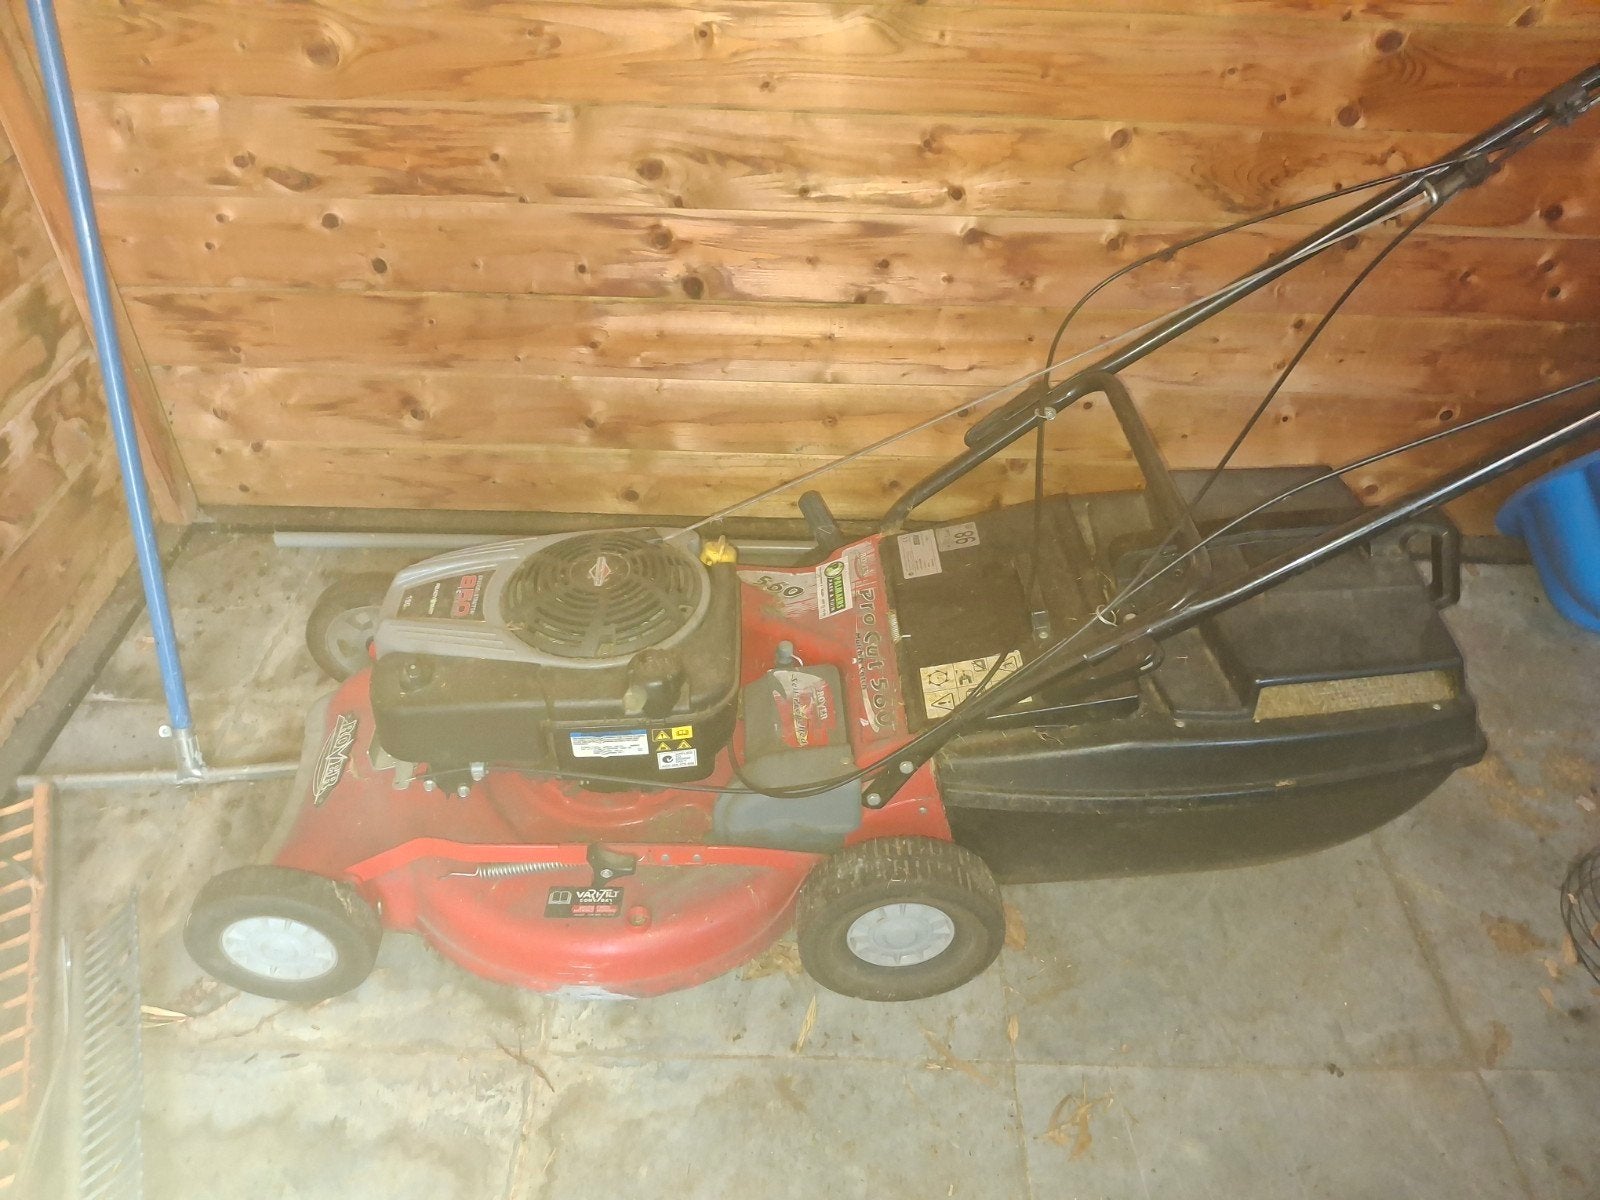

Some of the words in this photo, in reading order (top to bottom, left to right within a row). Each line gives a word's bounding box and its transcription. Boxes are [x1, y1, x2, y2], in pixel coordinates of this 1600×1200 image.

[753, 575, 805, 597] 560
[857, 588, 876, 626] Pro
[863, 630, 885, 670] Cut
[816, 689, 829, 720] ROVER
[317, 717, 357, 798] ROVER
